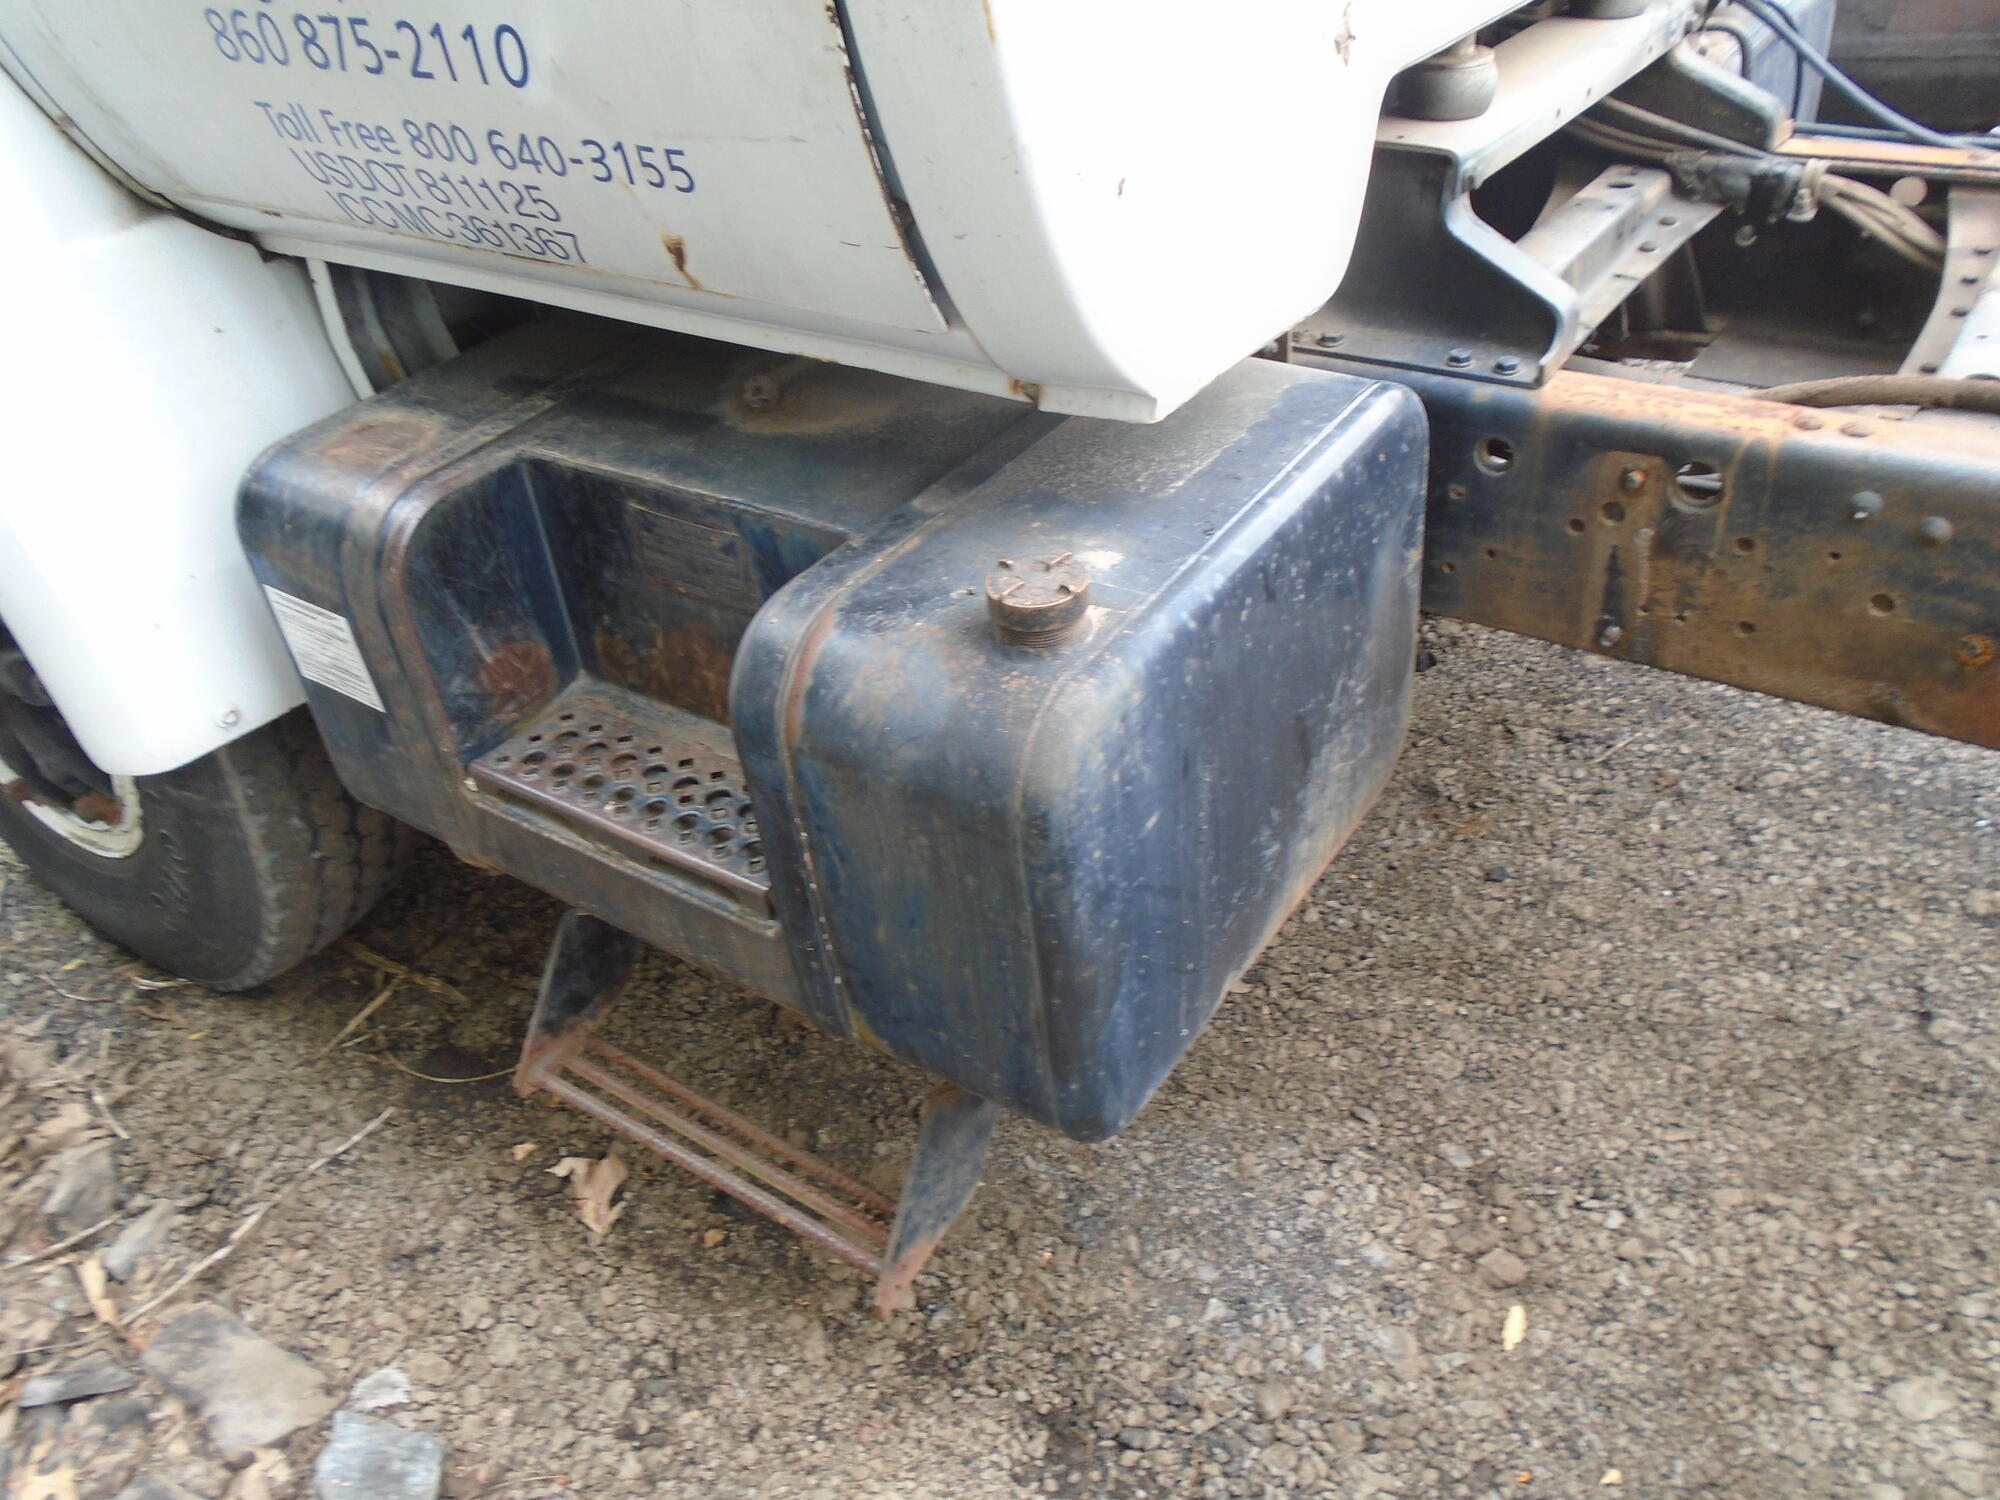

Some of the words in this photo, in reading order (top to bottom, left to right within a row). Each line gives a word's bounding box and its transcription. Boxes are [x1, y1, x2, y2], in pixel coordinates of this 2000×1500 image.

[204, 7, 289, 67] 860
[292, 12, 530, 89] 875-2110
[253, 100, 323, 144] Toll
[318, 108, 401, 155] Free
[402, 118, 479, 166] 800
[486, 128, 695, 194] 640-3155
